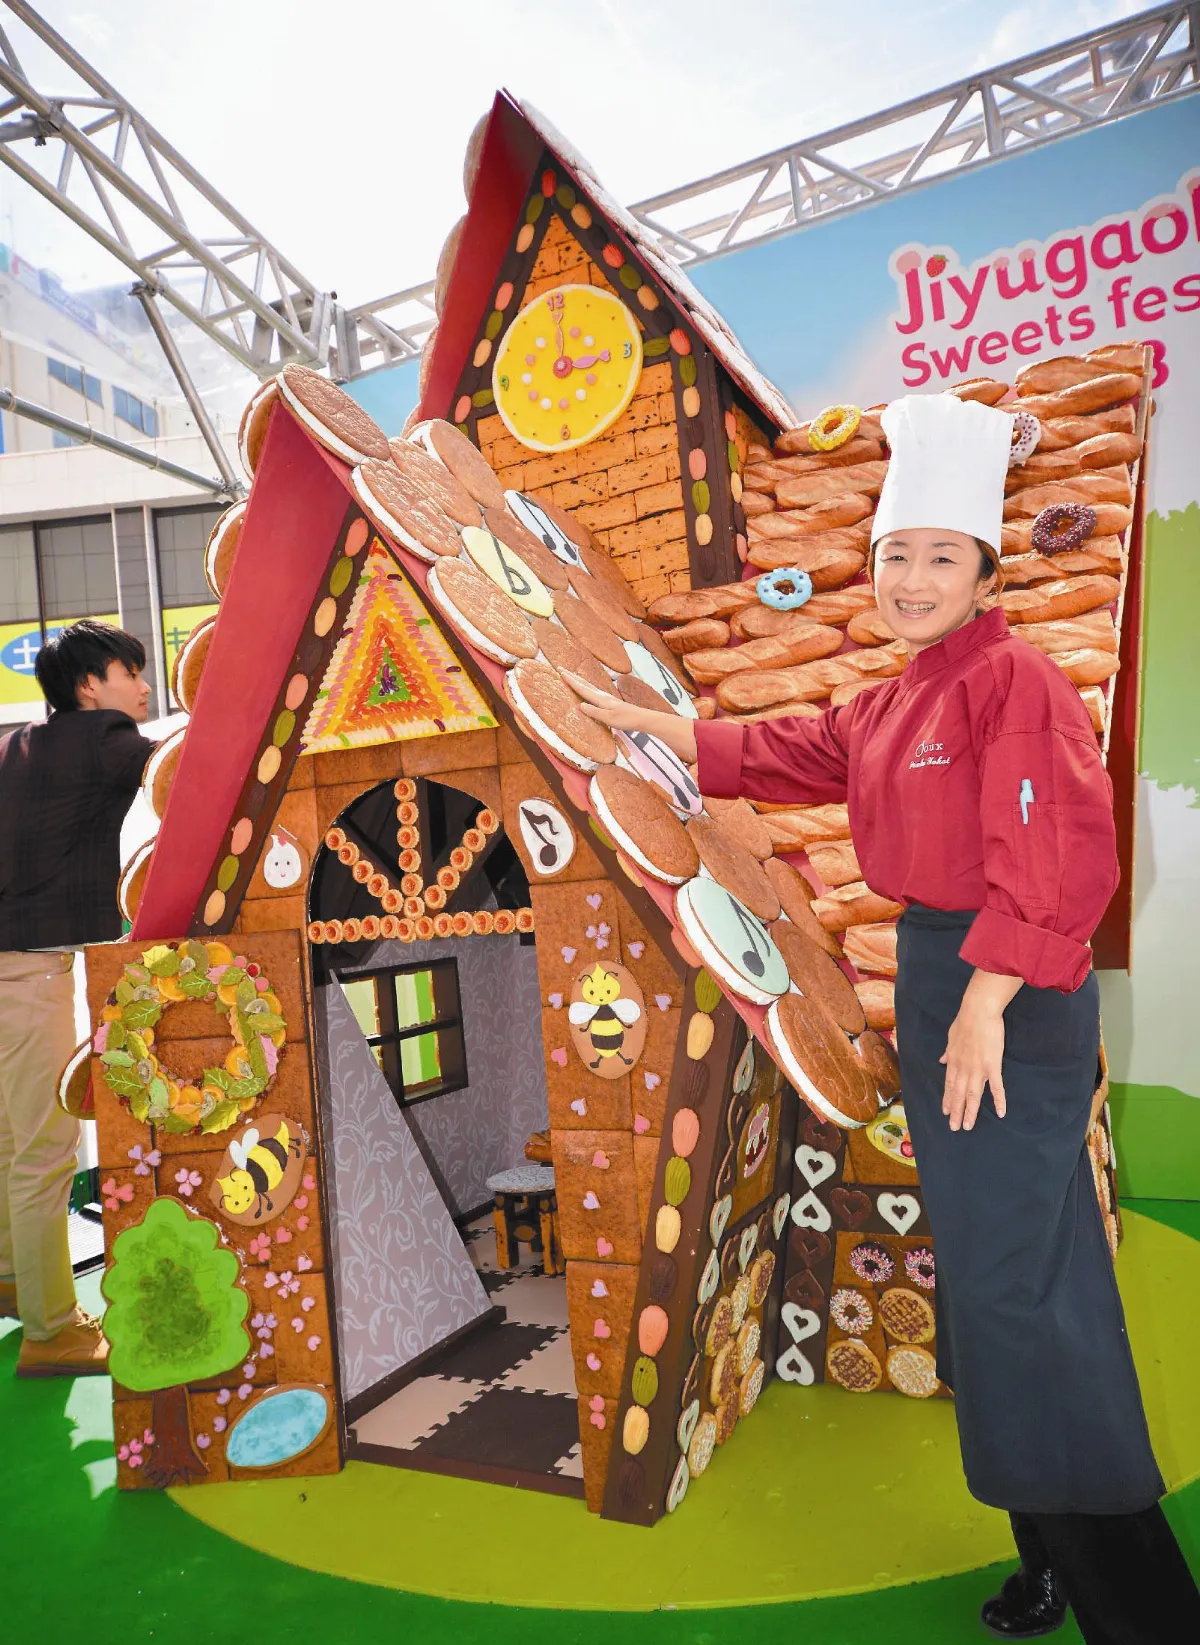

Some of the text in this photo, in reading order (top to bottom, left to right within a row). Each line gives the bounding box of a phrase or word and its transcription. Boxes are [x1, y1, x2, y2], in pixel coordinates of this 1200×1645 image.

[895, 175, 1200, 335] Jiyugao
[547, 293, 565, 311] 12
[623, 341, 632, 358] 3
[901, 305, 1096, 387] Sweets
[500, 376, 509, 391] 9
[561, 424, 570, 440] 6
